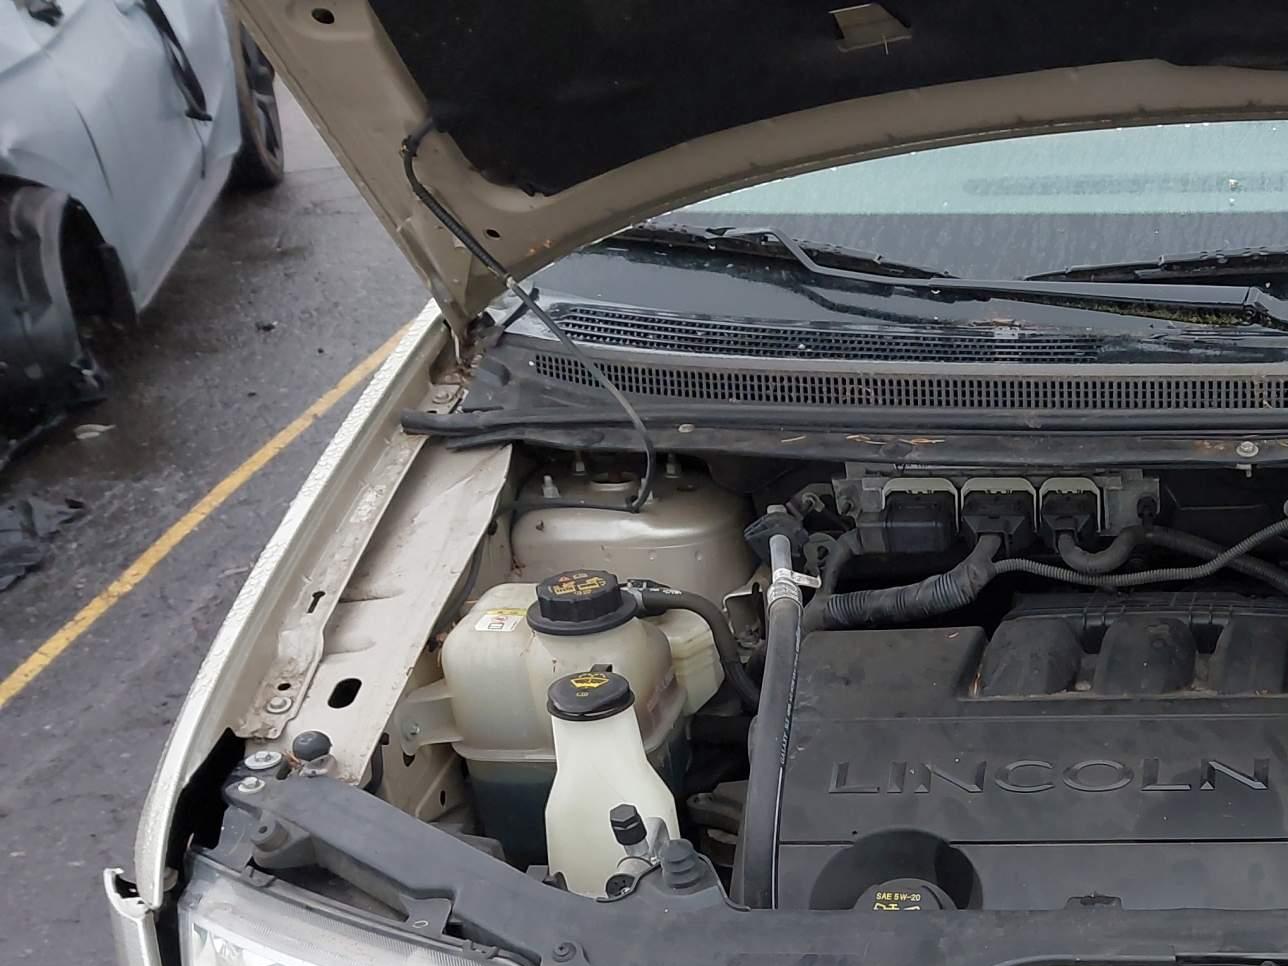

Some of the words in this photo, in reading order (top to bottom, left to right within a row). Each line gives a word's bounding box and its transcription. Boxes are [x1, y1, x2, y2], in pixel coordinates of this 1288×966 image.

[828, 757, 1270, 794] LINCOLN
[876, 892, 892, 901] SAE
[893, 892, 921, 902] 5W-20
